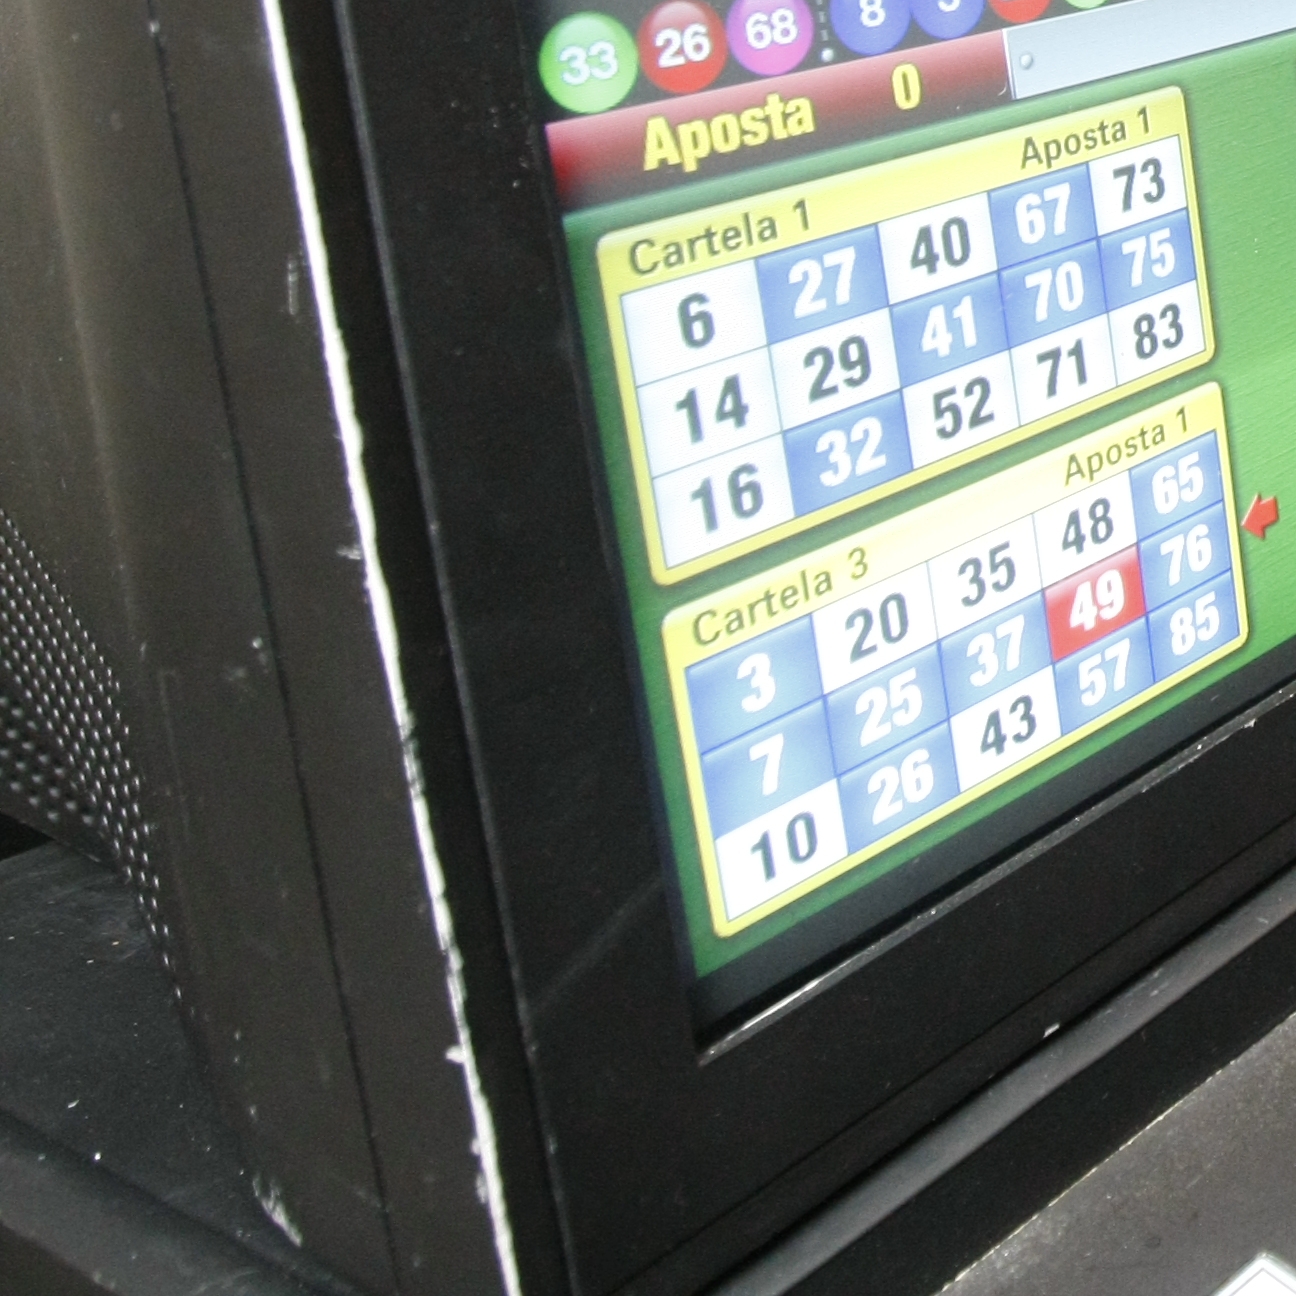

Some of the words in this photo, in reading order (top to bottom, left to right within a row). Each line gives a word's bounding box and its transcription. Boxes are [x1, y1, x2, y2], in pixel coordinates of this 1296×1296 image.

[560, 41, 618, 85] 33
[655, 26, 711, 67] 26
[745, 8, 799, 50] 68
[643, 92, 814, 172] Aposta
[891, 63, 921, 109] 0
[629, 210, 778, 277] Cartela
[793, 198, 811, 231] 1
[1020, 117, 1127, 169] Aposta
[1138, 106, 1152, 135] 1
[678, 292, 715, 349] 6
[788, 247, 857, 319] 27
[910, 216, 971, 277] 40
[1015, 183, 1071, 244] 67
[1113, 158, 1166, 212] 73
[675, 375, 749, 445] 14
[804, 334, 871, 404] 29
[921, 296, 978, 357] 41
[1025, 260, 1084, 323] 70
[1122, 228, 1175, 287] 75
[691, 463, 764, 534] 16
[815, 417, 887, 488] 32
[932, 377, 995, 440] 52
[1037, 339, 1089, 399] 71
[1134, 302, 1184, 360] 83
[693, 565, 834, 646] Cartela
[848, 547, 869, 578] 3
[1064, 425, 1167, 486] Aposta
[1176, 407, 1190, 433] 1
[738, 652, 776, 714] 3
[846, 593, 909, 664] 20
[958, 542, 1017, 607] 35
[1062, 496, 1115, 556] 48
[1151, 453, 1205, 514] 65
[749, 734, 785, 797] 7
[856, 668, 922, 748] 25
[968, 615, 1026, 688] 37
[1069, 569, 1125, 632] 49
[1161, 524, 1213, 586] 76
[751, 811, 819, 883] 10
[868, 747, 935, 826] 26
[980, 694, 1038, 757] 43
[1078, 638, 1131, 706] 57
[1170, 593, 1220, 656] 85
